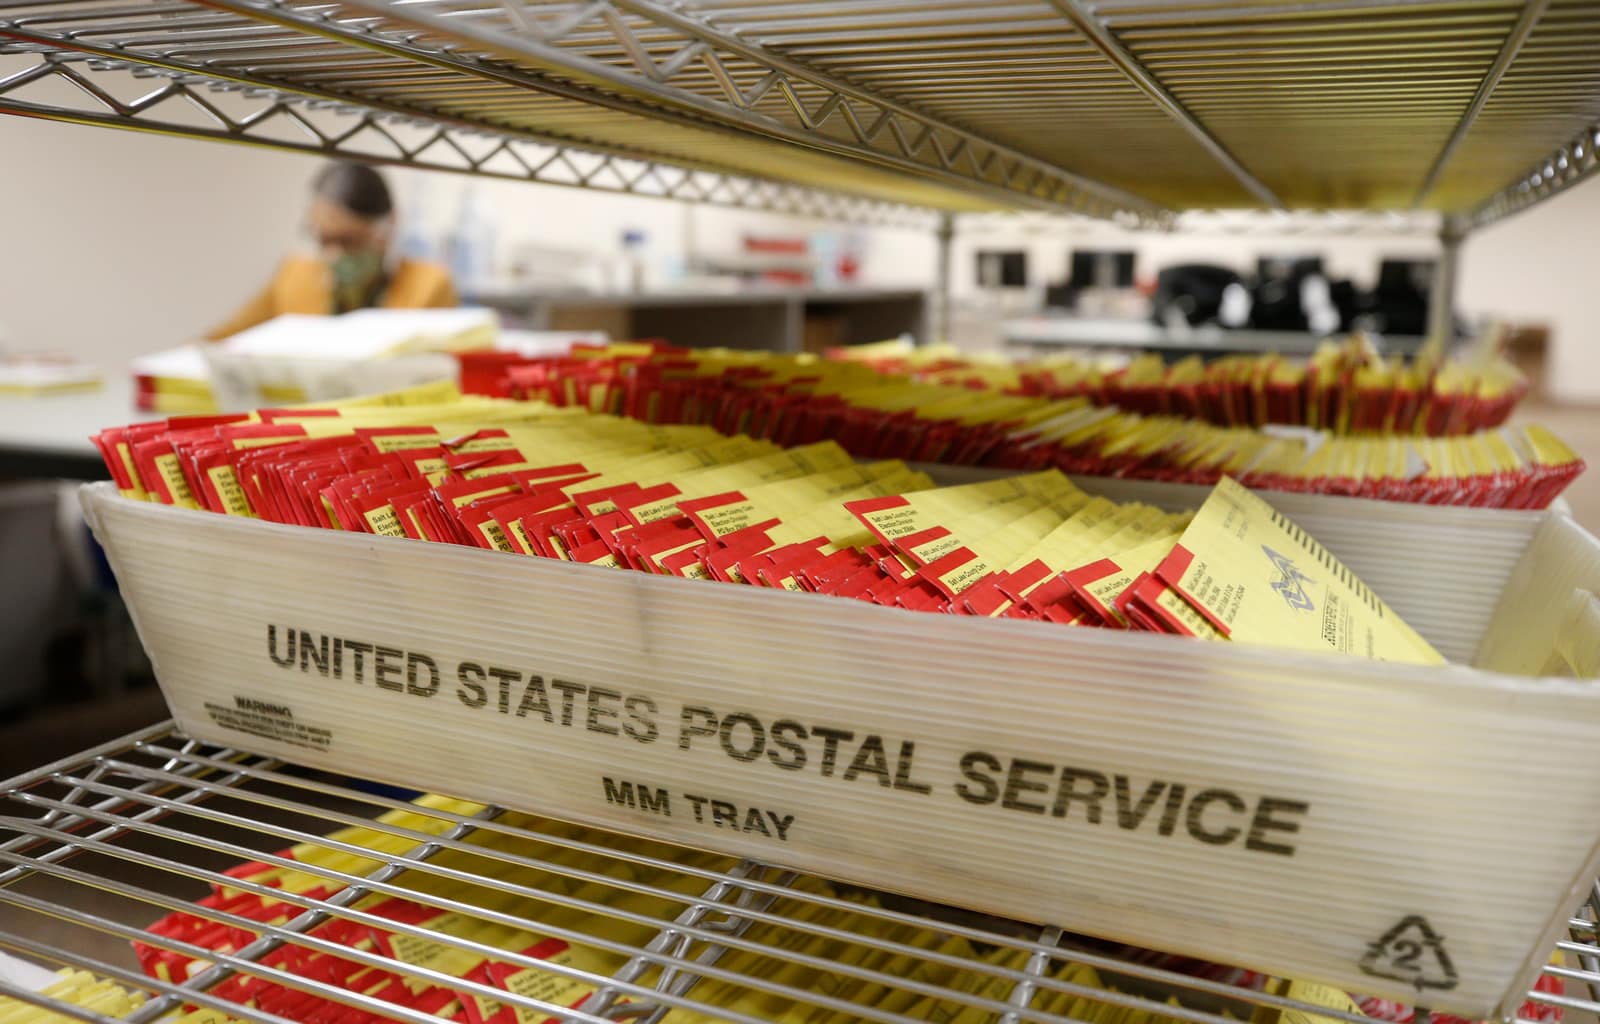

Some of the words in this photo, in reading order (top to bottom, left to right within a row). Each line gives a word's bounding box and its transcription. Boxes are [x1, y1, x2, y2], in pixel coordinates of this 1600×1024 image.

[948, 576, 959, 586] Salt
[233, 694, 293, 719] WARNING
[267, 624, 440, 698] UNITED
[456, 661, 658, 745] STATES
[677, 703, 932, 798] POSTAL
[954, 750, 1309, 858] SERVICE
[602, 776, 671, 818] MM
[683, 793, 795, 843] TRAY
[1391, 939, 1423, 971] 2
